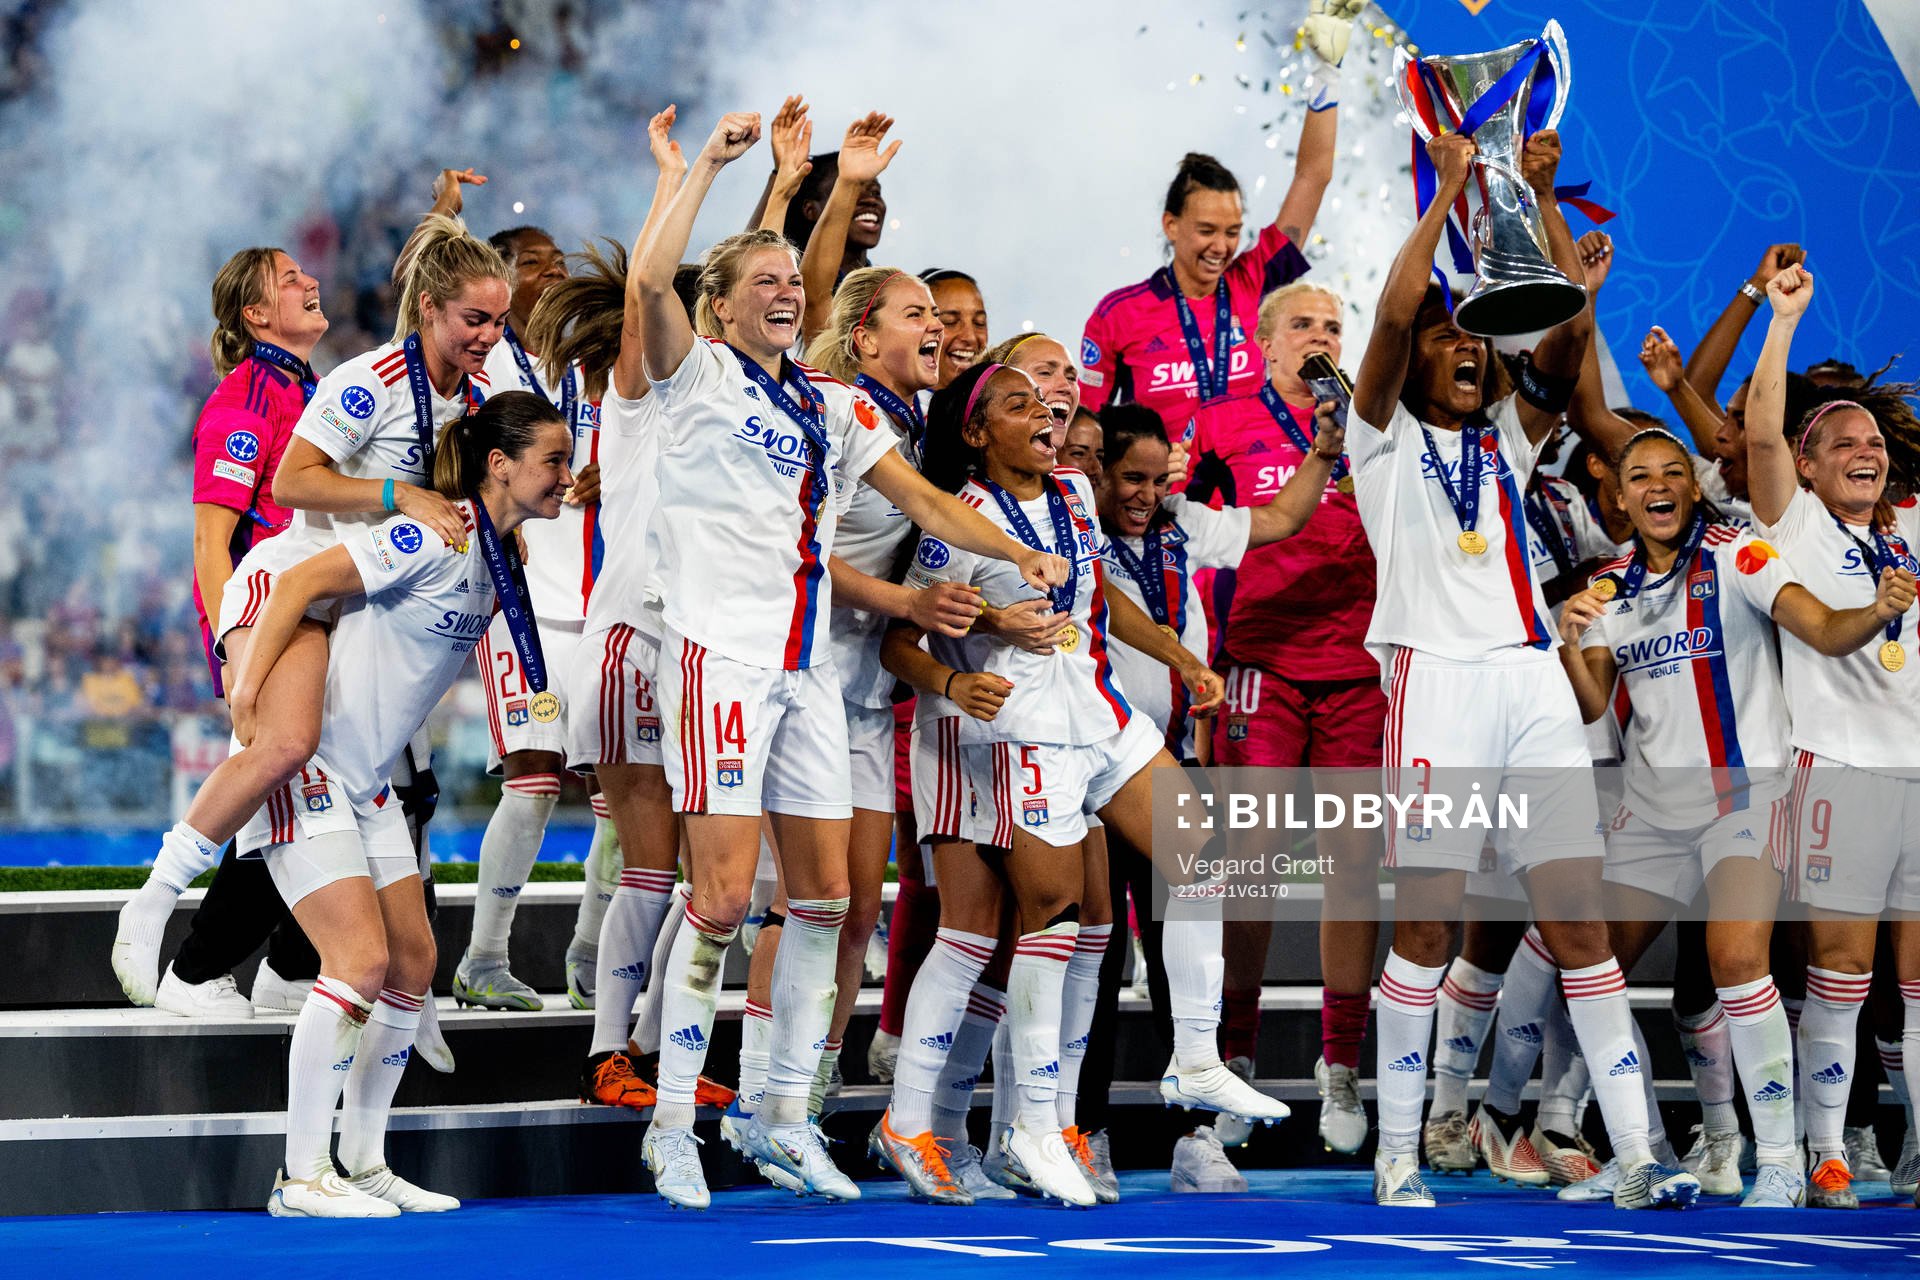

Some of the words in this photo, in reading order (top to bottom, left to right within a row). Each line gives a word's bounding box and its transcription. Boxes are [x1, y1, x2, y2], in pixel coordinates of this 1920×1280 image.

[413, 363, 424, 392] FINAL
[419, 395, 425, 403] 22
[778, 392, 802, 417] FINAL
[803, 416, 811, 425] 22
[741, 416, 809, 461] SWOR
[1000, 489, 1014, 511] TORINO
[1010, 508, 1019, 518] 22
[1017, 519, 1037, 547] FINAL
[483, 528, 495, 552] TORINO
[491, 552, 499, 561] 22
[494, 564, 509, 593] FINAL
[434, 610, 491, 635] SWOR
[1616, 626, 1713, 668] SWORD
[519, 632, 530, 655] TORINO
[526, 655, 534, 664] 22
[530, 667, 541, 690] FINA
[1648, 663, 1680, 679] VENUE
[497, 651, 527, 698] 21
[1225, 666, 1262, 714] 40
[640, 727, 659, 740] OL
[713, 701, 747, 755] 14
[720, 771, 742, 784] OL
[1021, 746, 1042, 795] 5
[309, 795, 332, 809] OL
[1026, 809, 1048, 824] OL
[1810, 799, 1832, 850] 9
[670, 1033, 708, 1051] adidas
[1811, 1072, 1848, 1085] adidas
[1753, 1087, 1792, 1102] adidas
